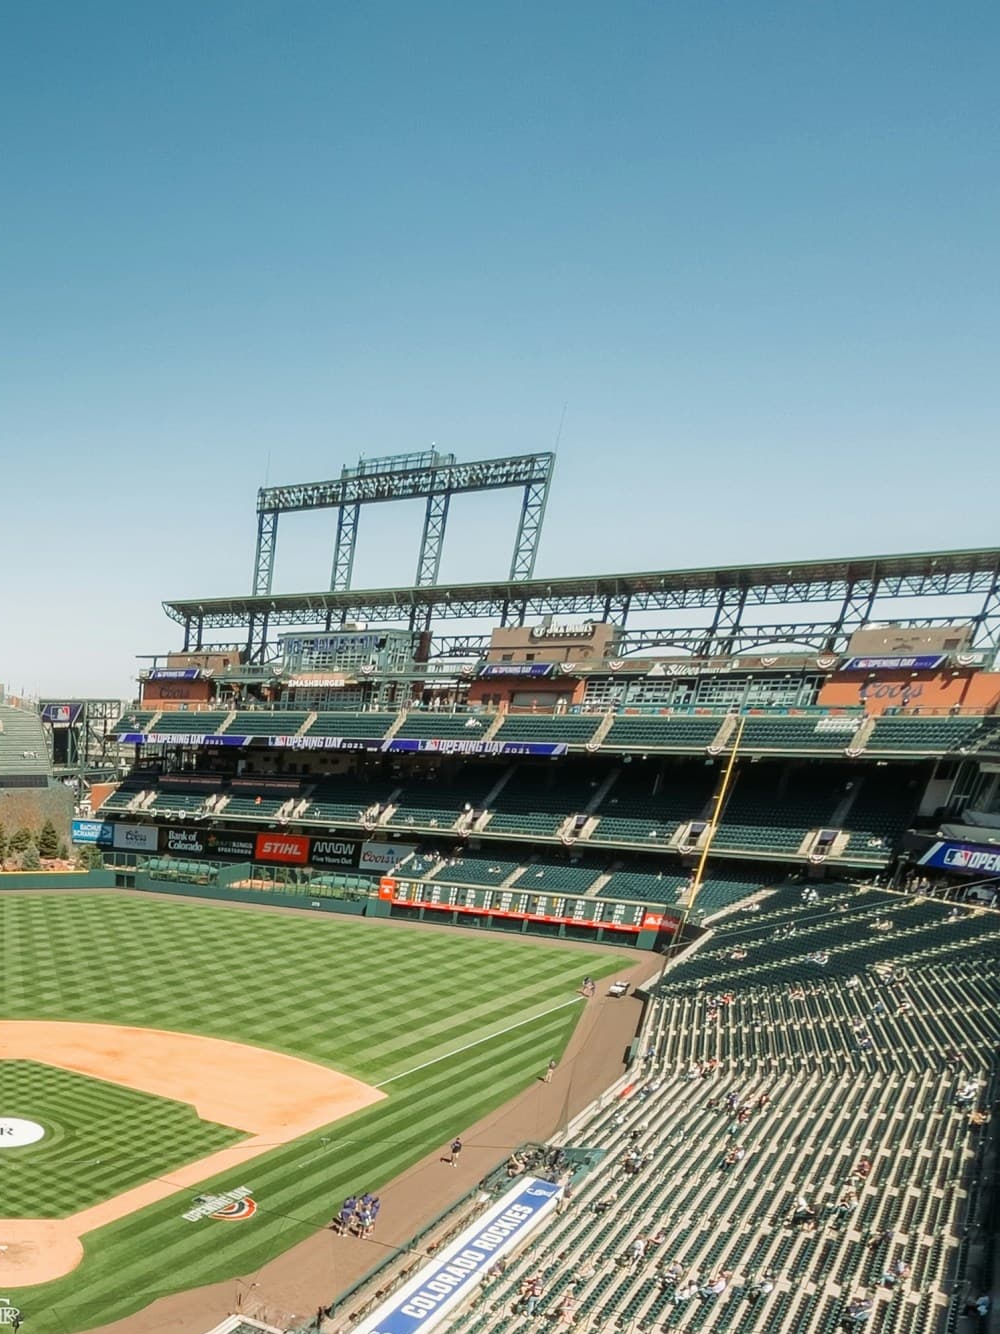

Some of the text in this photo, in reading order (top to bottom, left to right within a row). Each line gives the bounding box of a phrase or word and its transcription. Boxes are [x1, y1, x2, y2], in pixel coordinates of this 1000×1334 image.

[860, 681, 923, 699] Coors
[157, 735, 190, 744] OPENING
[190, 736, 206, 745] DAY
[286, 737, 324, 749] OPENING
[324, 738, 343, 749] DAY
[440, 741, 483, 752] OPENING
[484, 742, 506, 753] DAY
[169, 831, 198, 840] Bank of
[168, 840, 203, 851] Colorado
[262, 842, 303, 855] STIHL
[312, 855, 353, 865] Five Years Out
[401, 1203, 534, 1319] COLORADO ROCKIES
